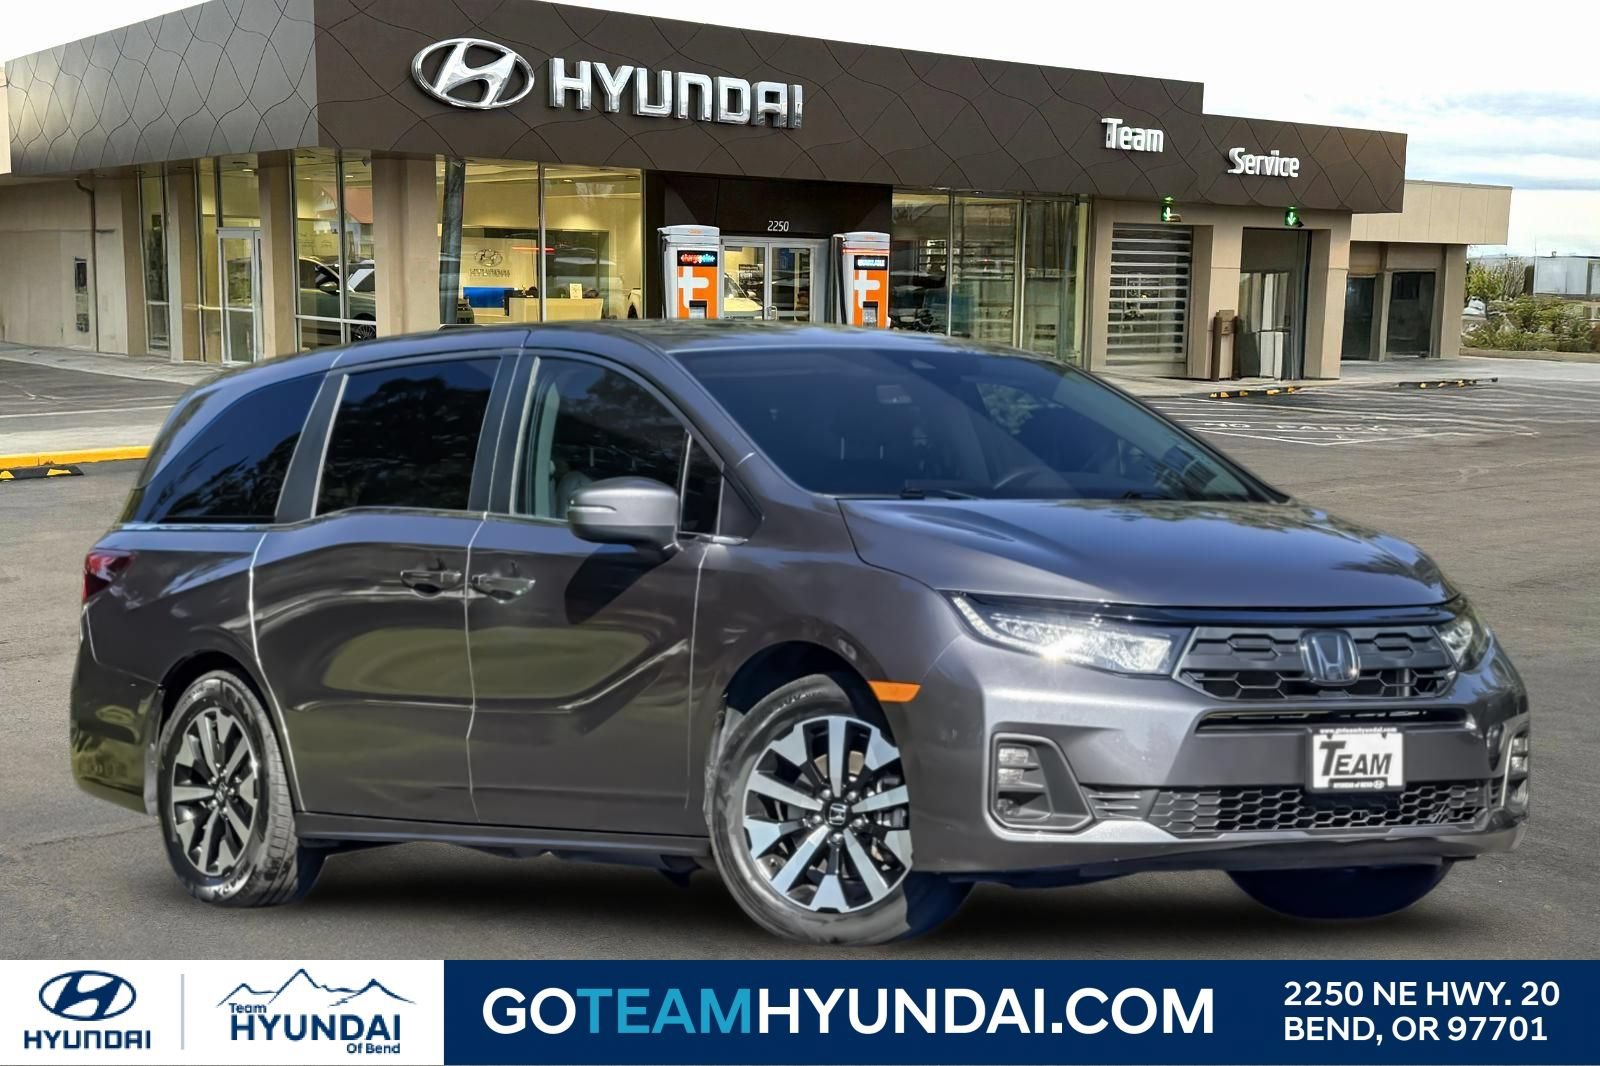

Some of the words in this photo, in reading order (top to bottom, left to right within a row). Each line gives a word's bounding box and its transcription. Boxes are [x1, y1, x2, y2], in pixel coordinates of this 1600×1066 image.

[549, 57, 804, 129] HYUNDAI
[1101, 117, 1164, 152] Team
[1227, 147, 1300, 177] Service
[767, 220, 790, 232] 2250
[1319, 740, 1393, 777] TEAM
